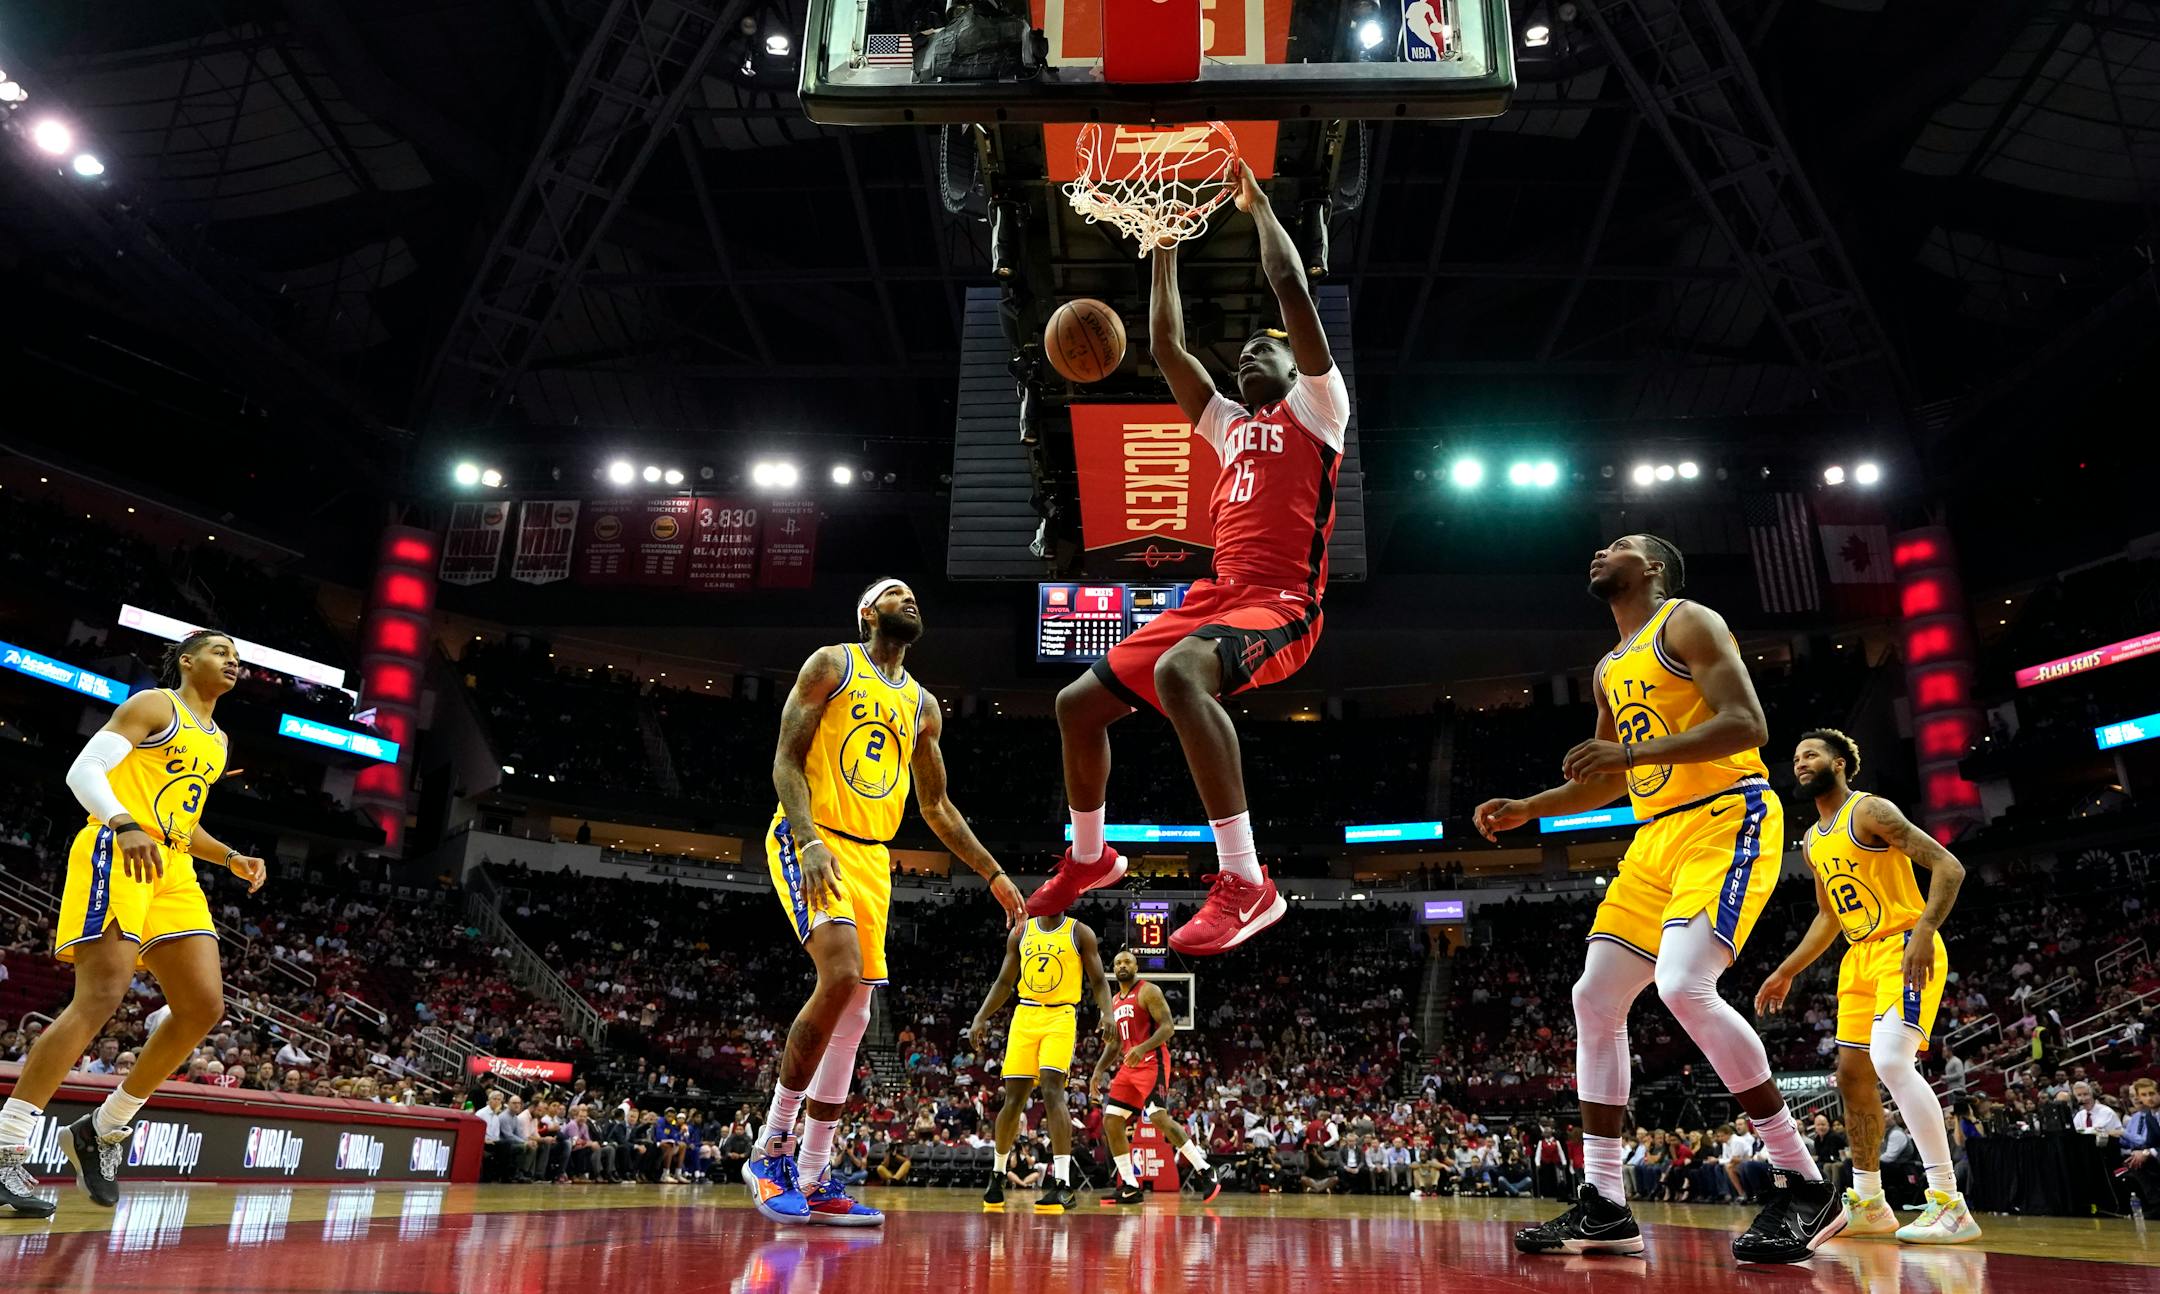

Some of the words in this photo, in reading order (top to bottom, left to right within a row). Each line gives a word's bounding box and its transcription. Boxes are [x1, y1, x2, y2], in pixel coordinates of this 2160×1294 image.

[1411, 47, 1431, 59] NBA
[1123, 423, 1191, 531] ROCKETS
[1229, 459, 1255, 502] 15
[699, 508, 757, 531] 3,830
[693, 547, 756, 557] OLAJUWON
[702, 534, 752, 544] HAKEEM
[1098, 597, 1108, 611] 0
[2039, 662, 2070, 681] FLASH
[2071, 650, 2105, 672] SEATS
[848, 689, 868, 700] The
[1608, 680, 1656, 706] ITY
[851, 702, 907, 738] CITY
[1618, 711, 1654, 743] 22
[164, 745, 188, 757] The
[865, 729, 885, 762] 2
[166, 757, 217, 781] CIT
[183, 783, 201, 813] 3
[94, 830, 112, 911] WARRIORS
[1727, 812, 1761, 906] WARRIORS
[1814, 857, 1858, 875] ITY
[780, 834, 804, 911] WARRIORS
[1831, 883, 1863, 915] 12
[1136, 912, 1163, 925] 10:47
[1143, 925, 1160, 944] 13
[1025, 944, 1065, 956] CITY
[1038, 957, 1049, 972] 7
[1120, 1020, 1129, 1040] 17
[489, 1060, 554, 1078] Budweiser
[142, 1122, 179, 1167] NBA
[173, 1124, 202, 1174] App
[255, 1128, 285, 1168] NBA
[280, 1130, 303, 1175] App
[345, 1134, 369, 1169] NBA
[365, 1135, 384, 1176] App
[417, 1139, 437, 1171] NBA
[435, 1139, 450, 1177] App
